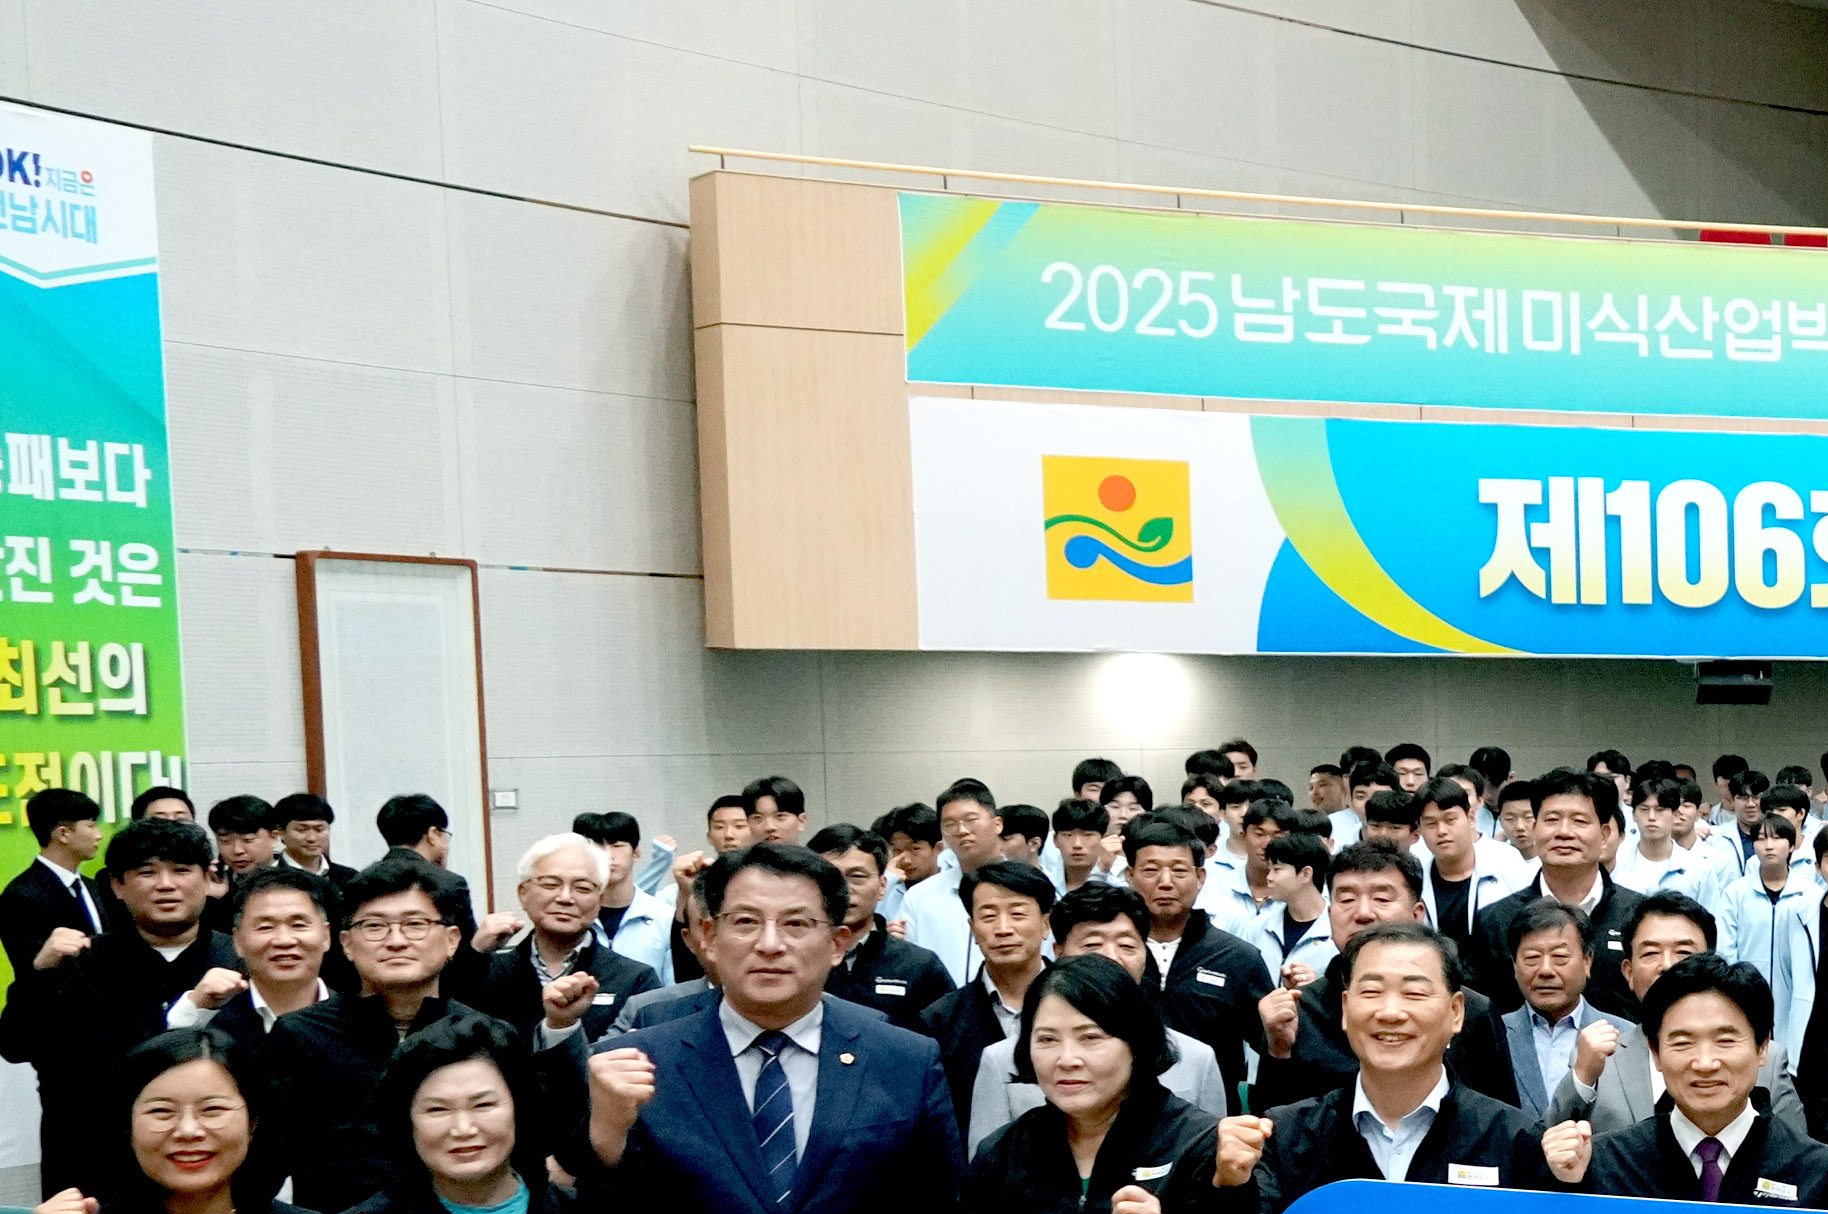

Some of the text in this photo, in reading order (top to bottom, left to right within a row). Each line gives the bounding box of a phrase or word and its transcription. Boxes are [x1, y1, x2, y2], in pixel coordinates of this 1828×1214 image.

[0, 148, 96, 197] K! 지금은
[0, 431, 153, 508] 패보다
[0, 535, 163, 608] 진 것은
[0, 637, 147, 715] 최선의
